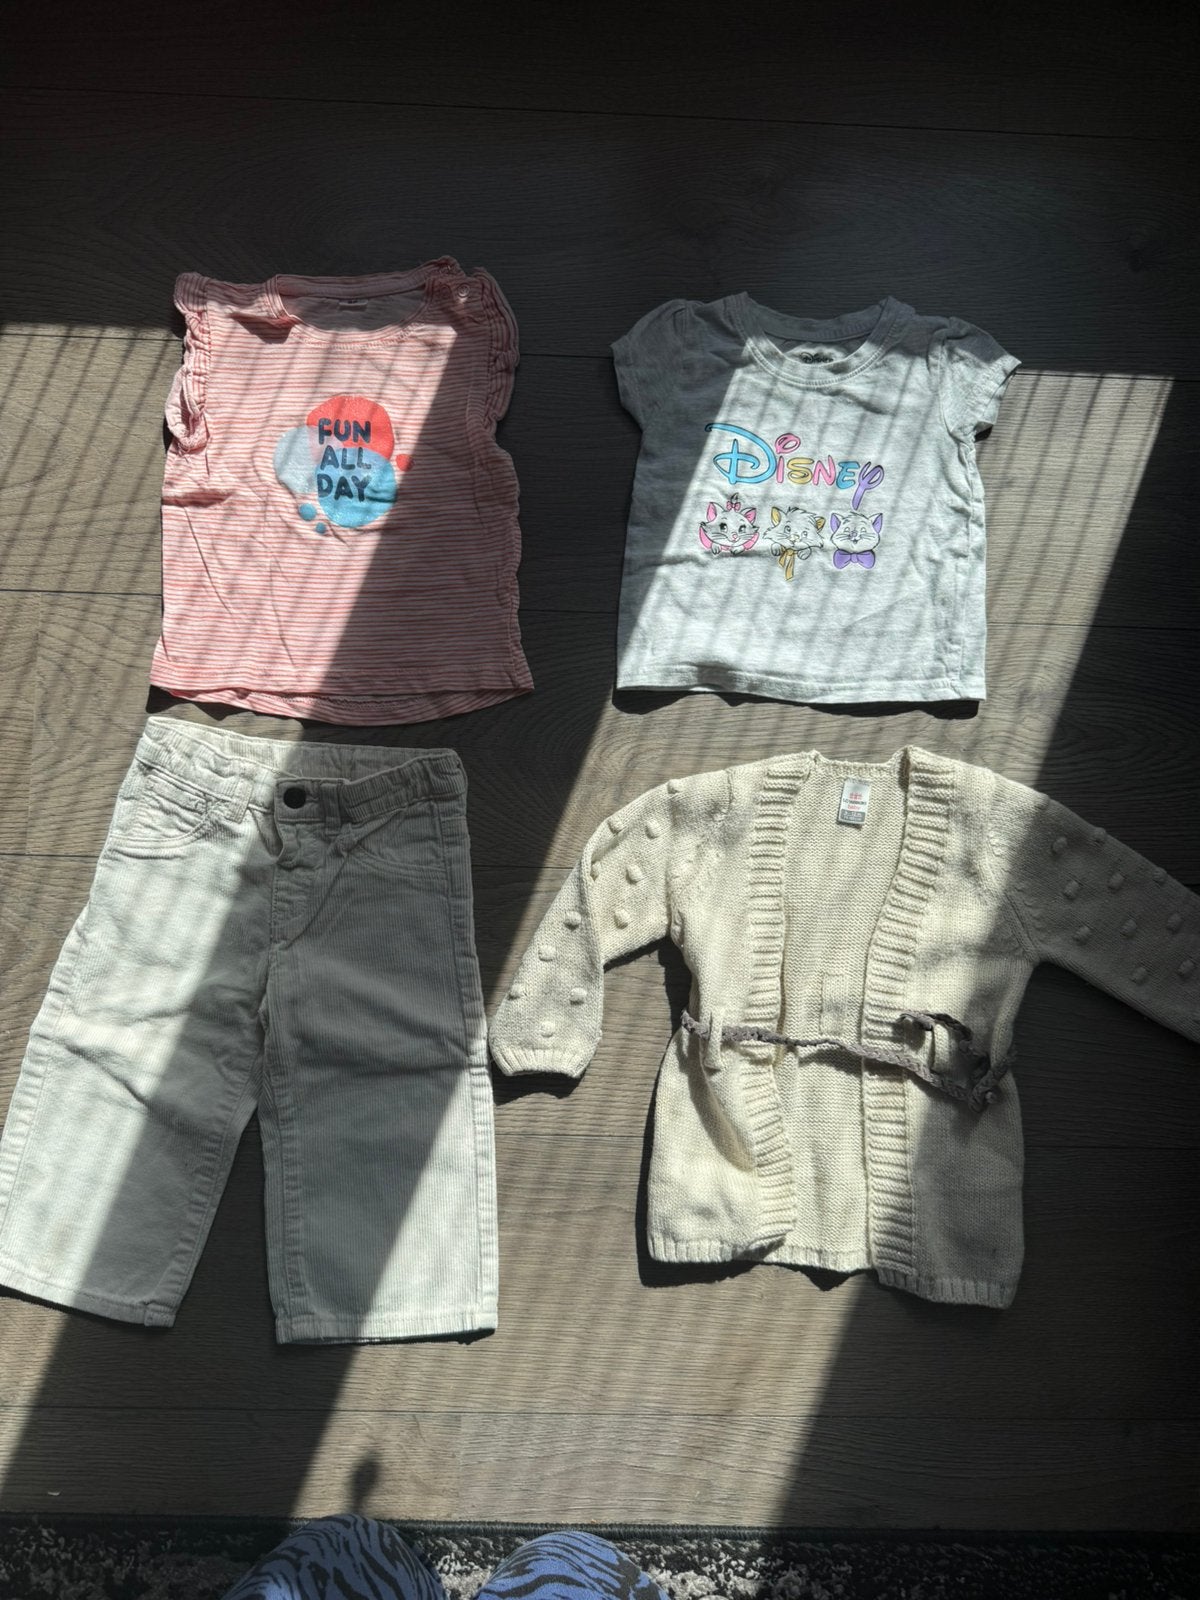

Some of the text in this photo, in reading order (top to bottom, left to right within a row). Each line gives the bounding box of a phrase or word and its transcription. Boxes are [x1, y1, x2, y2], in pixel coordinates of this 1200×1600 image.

[318, 417, 371, 445] FUN
[319, 445, 372, 470] ALL
[316, 473, 372, 502] DAY
